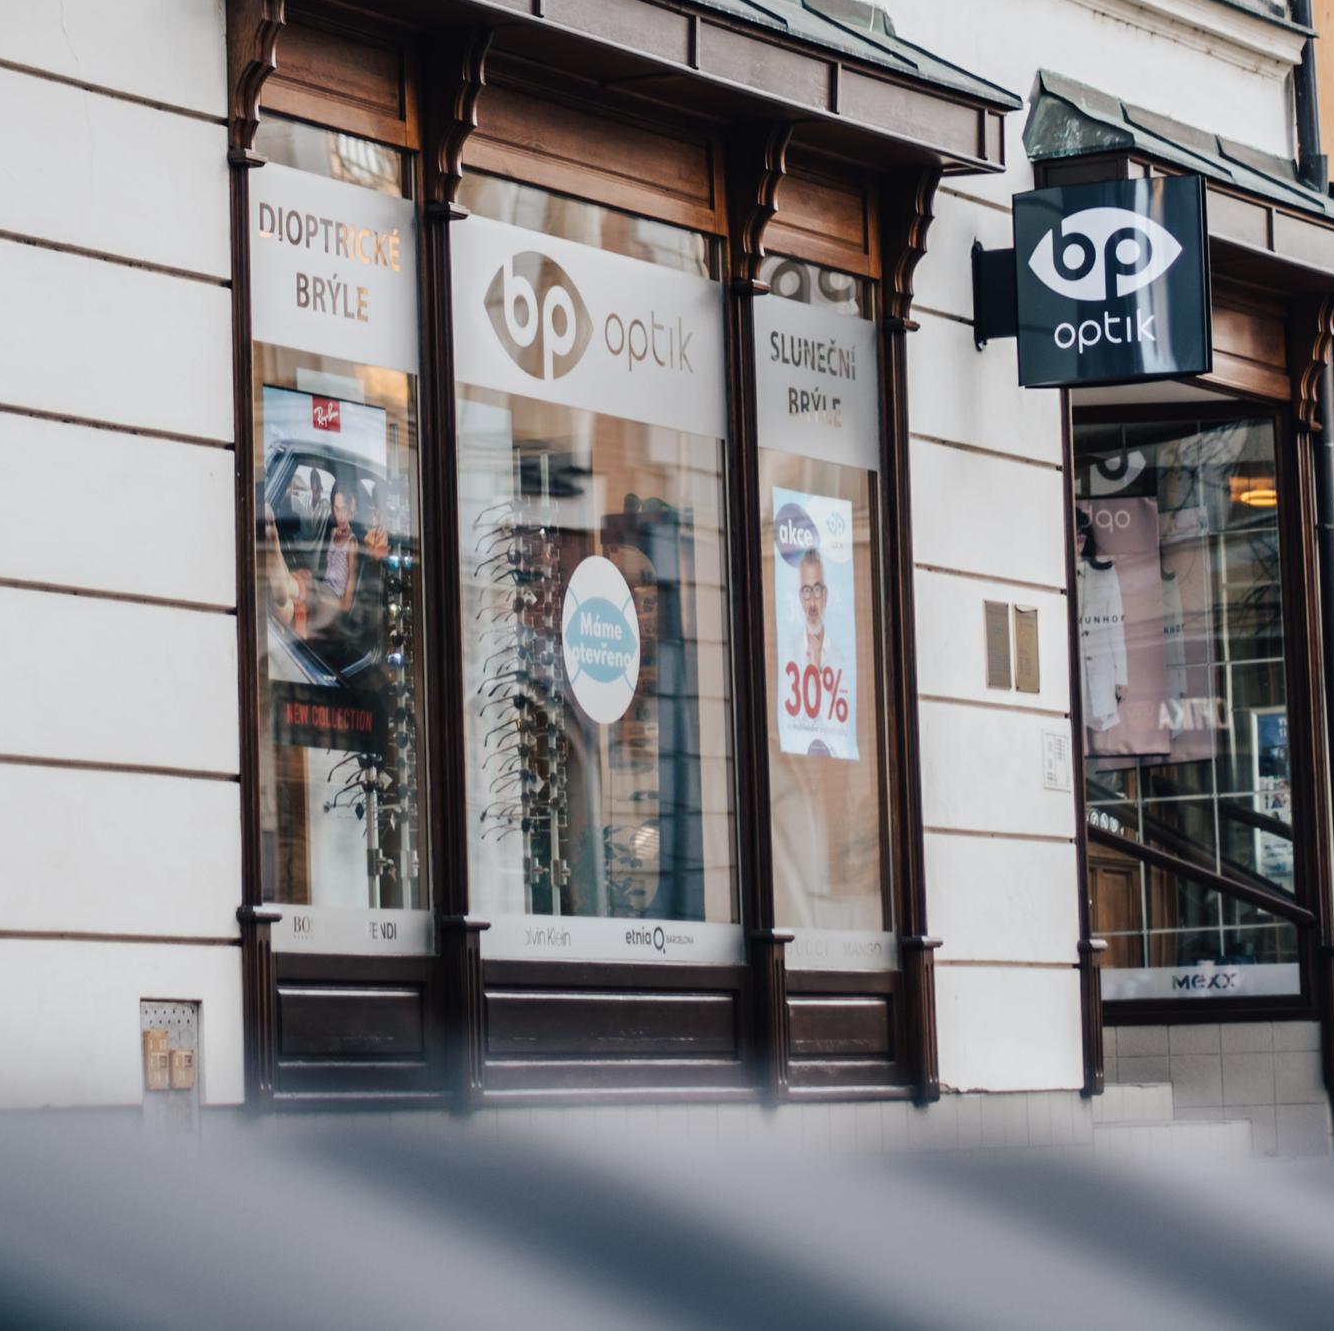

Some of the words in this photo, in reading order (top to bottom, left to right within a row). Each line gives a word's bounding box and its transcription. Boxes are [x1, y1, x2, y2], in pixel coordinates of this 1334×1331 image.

[258, 201, 402, 273] DIOPTRICKÉ
[295, 272, 370, 324] BRÝLE
[604, 310, 695, 374] optik
[1054, 311, 1156, 354] optik
[770, 330, 856, 381] SLUNEČNÍ
[788, 387, 843, 428] BRÝLE
[779, 518, 814, 548] akce
[579, 611, 623, 641] Máme
[571, 642, 633, 669] otevřeno
[784, 661, 848, 723] 30%
[285, 702, 309, 726] NEW
[312, 704, 374, 733] COLLECTION
[625, 926, 652, 946] etnia
